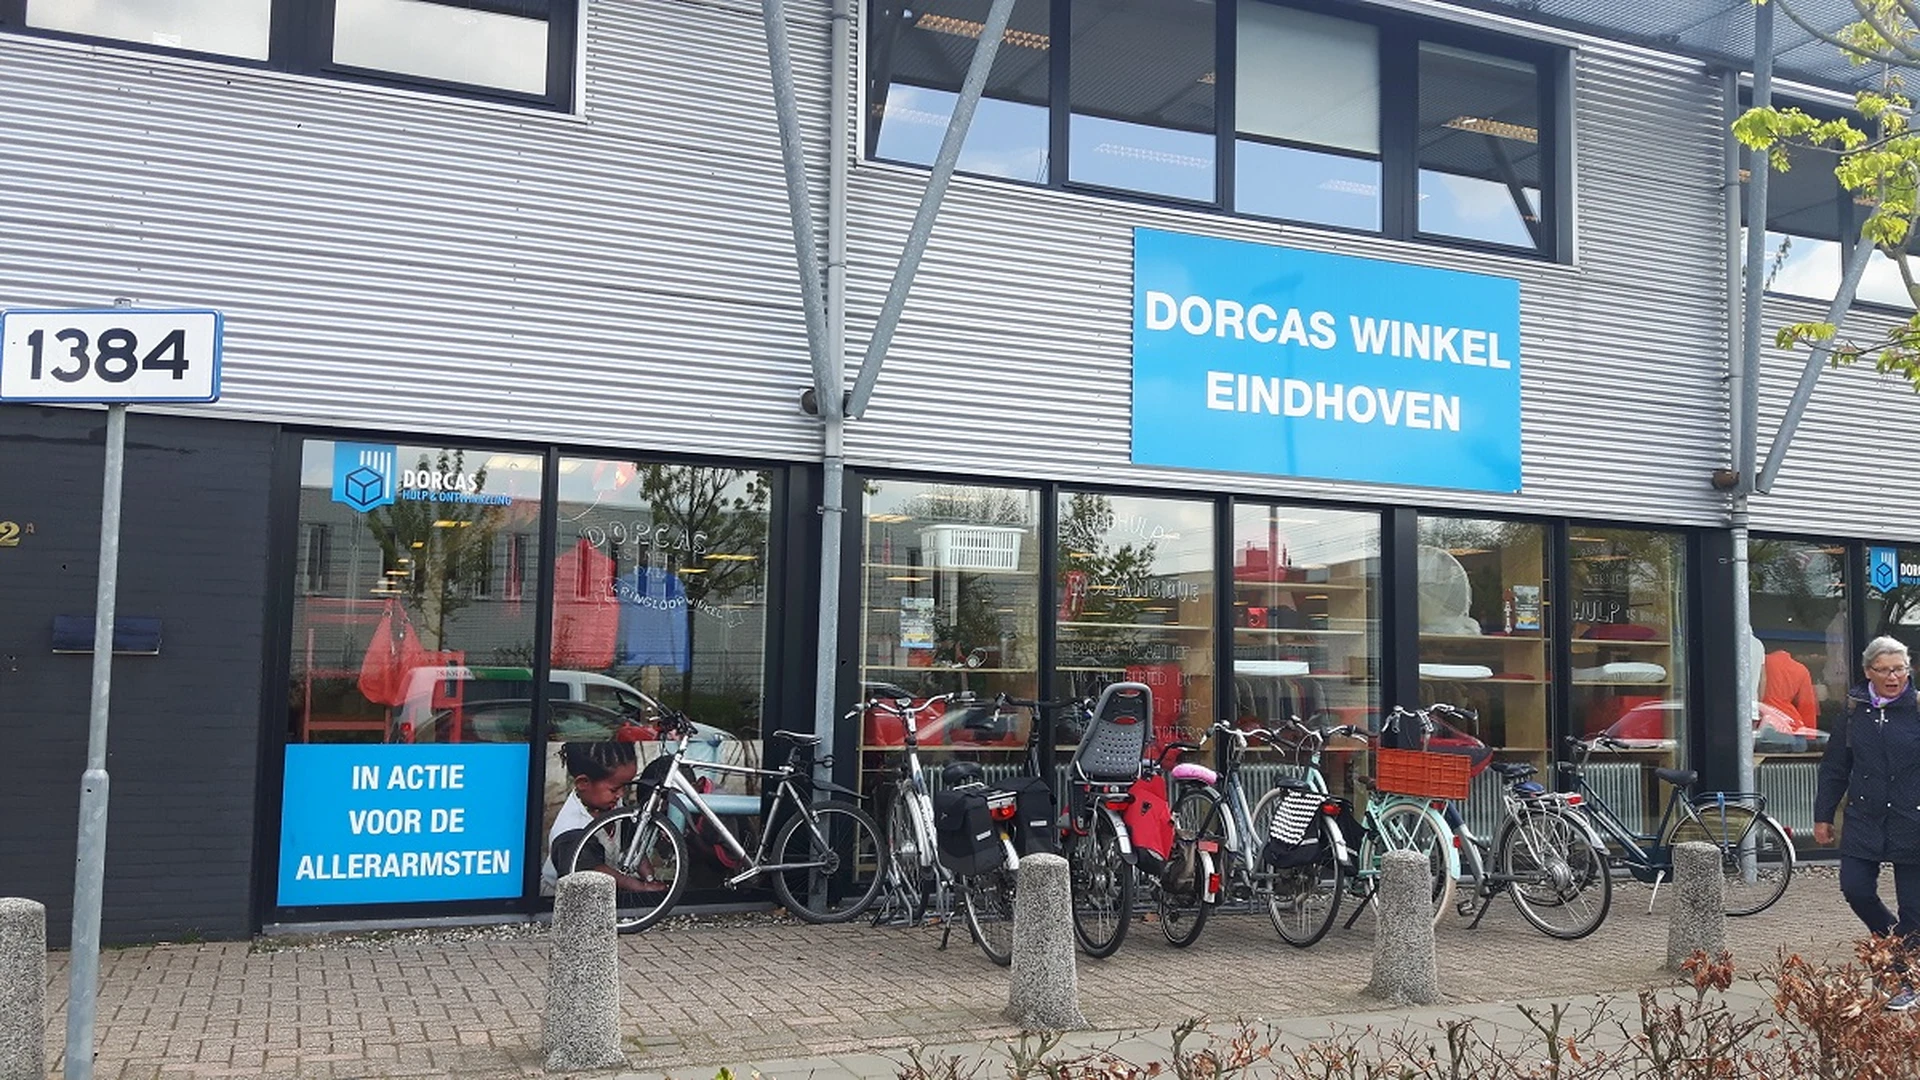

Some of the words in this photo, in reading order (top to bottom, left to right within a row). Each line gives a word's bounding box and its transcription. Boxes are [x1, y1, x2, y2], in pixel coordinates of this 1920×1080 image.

[1145, 290, 1337, 350] DORCAS
[1349, 314, 1511, 369] WINKEL
[27, 327, 189, 383] 1384
[1206, 370, 1460, 432] EINDHOVEN
[403, 470, 478, 492] DORCAS
[403, 489, 428, 501] HULP
[579, 520, 708, 555] DORCAS
[610, 583, 724, 619] KRINGLOOPWINKEL
[1571, 599, 1620, 623] HULP
[352, 765, 379, 790] IN
[387, 764, 465, 790] ACTIE
[349, 809, 421, 835] VOOR
[430, 808, 465, 833] DE
[295, 849, 510, 880] ALLERARMSTEN
